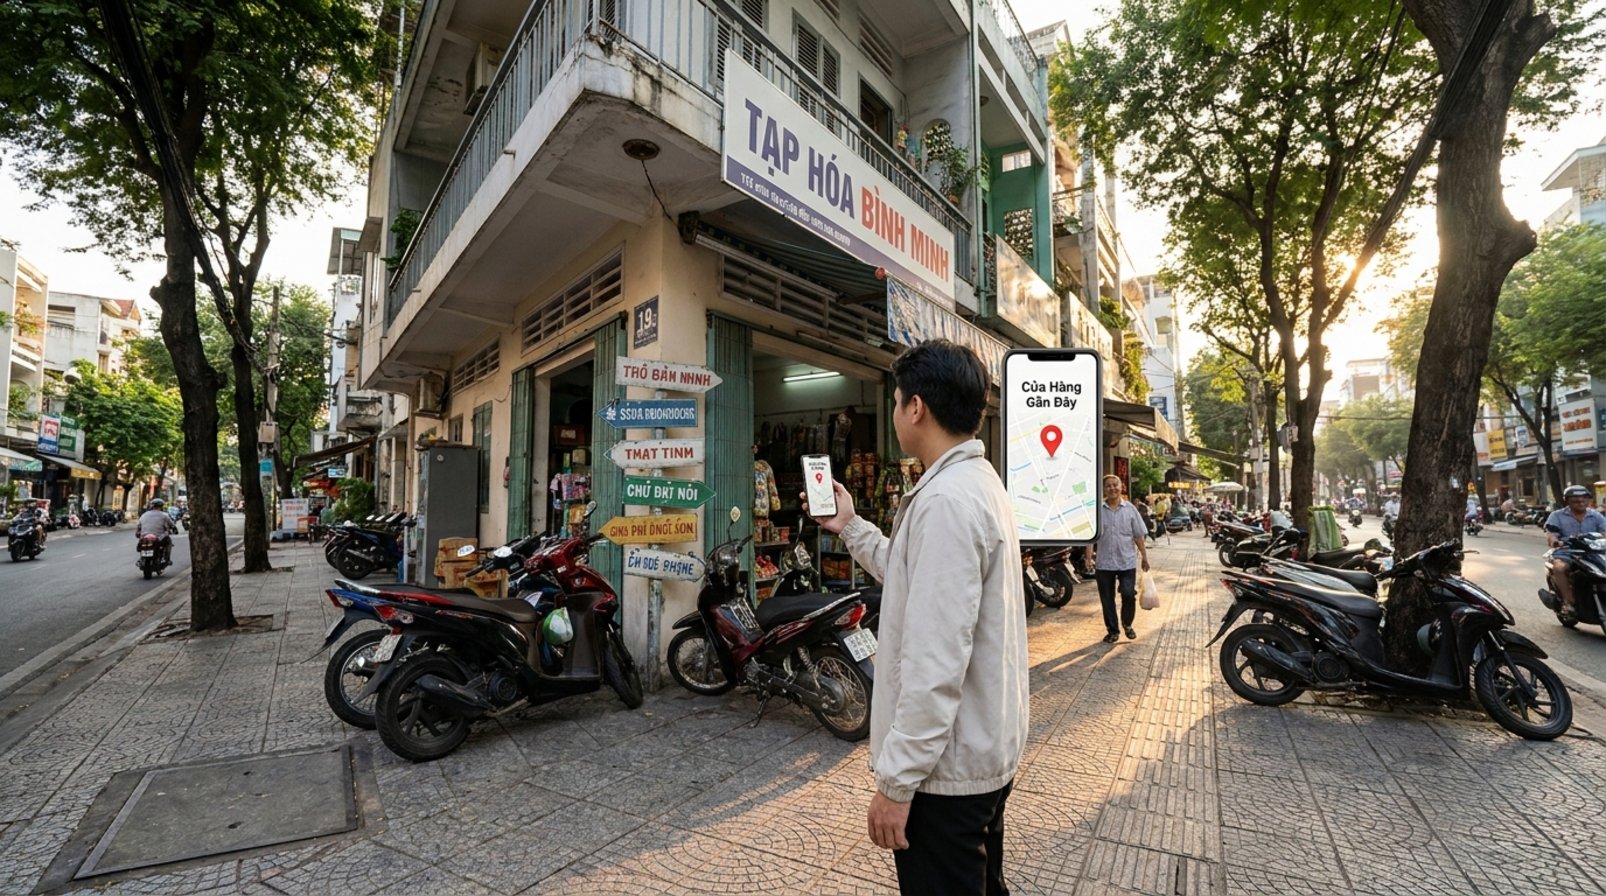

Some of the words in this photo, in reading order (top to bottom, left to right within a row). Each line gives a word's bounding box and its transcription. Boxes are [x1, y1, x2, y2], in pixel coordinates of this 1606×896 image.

[745, 98, 801, 177] TẠP
[807, 146, 856, 220] HÓA
[861, 184, 906, 253] BÌNH
[910, 223, 950, 283] MINH
[1049, 380, 1082, 395] Hàng
